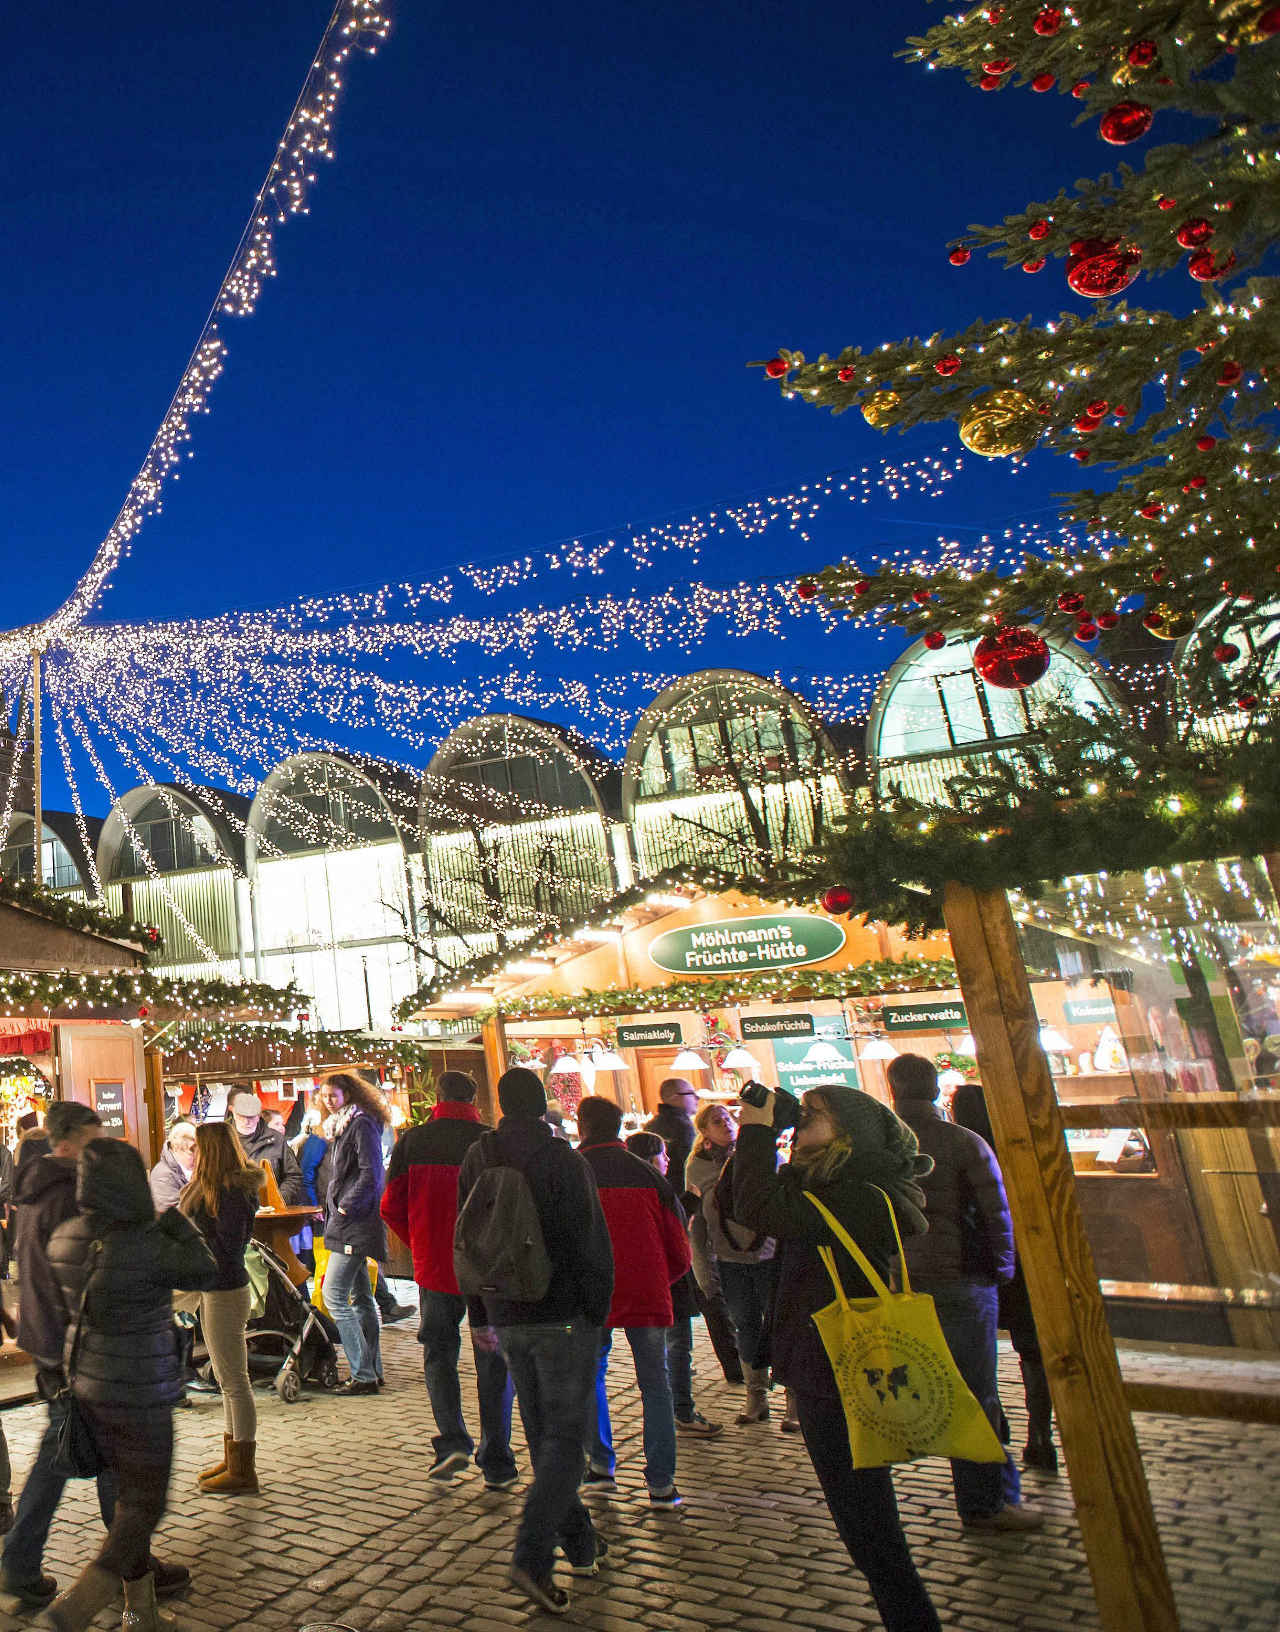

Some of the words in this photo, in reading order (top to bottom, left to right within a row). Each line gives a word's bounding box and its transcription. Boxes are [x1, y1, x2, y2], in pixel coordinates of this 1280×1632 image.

[691, 924, 793, 949] Möhlmann's
[685, 941, 808, 968] Früchte-Hütte
[889, 1008, 962, 1024] Zuckerwatte
[744, 1020, 811, 1034] Schokofrüchte
[623, 1030, 676, 1043] Salmiaklolly
